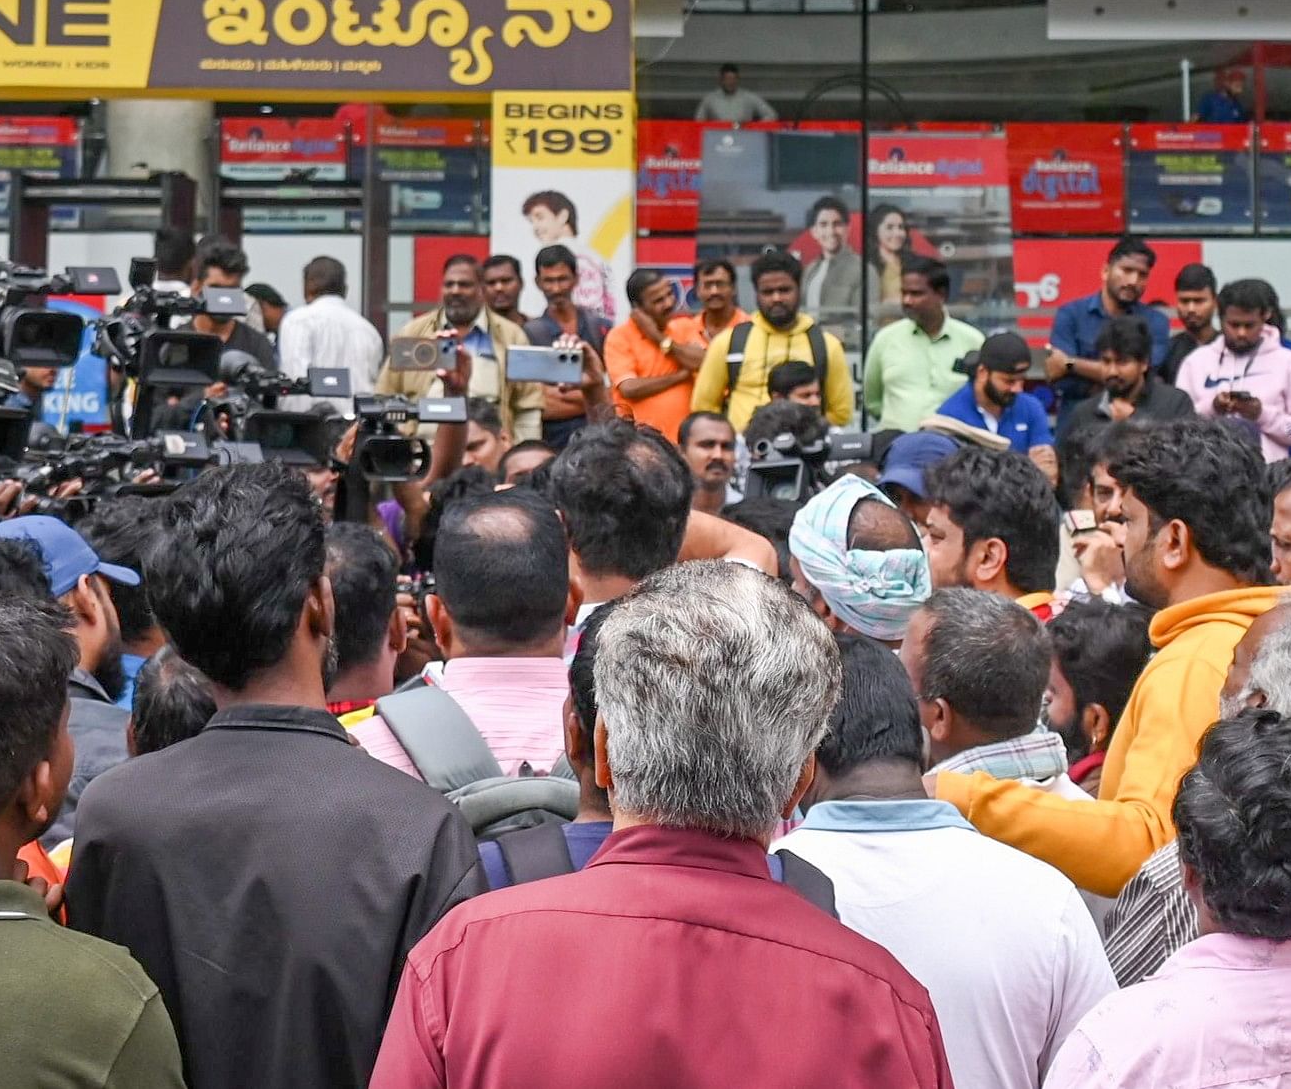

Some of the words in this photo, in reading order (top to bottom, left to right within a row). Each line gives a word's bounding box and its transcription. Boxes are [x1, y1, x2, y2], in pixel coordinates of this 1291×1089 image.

[2, 60, 62, 69] WOMEN
[504, 103, 623, 120] BEGINS
[1021, 164, 1101, 203] digital
